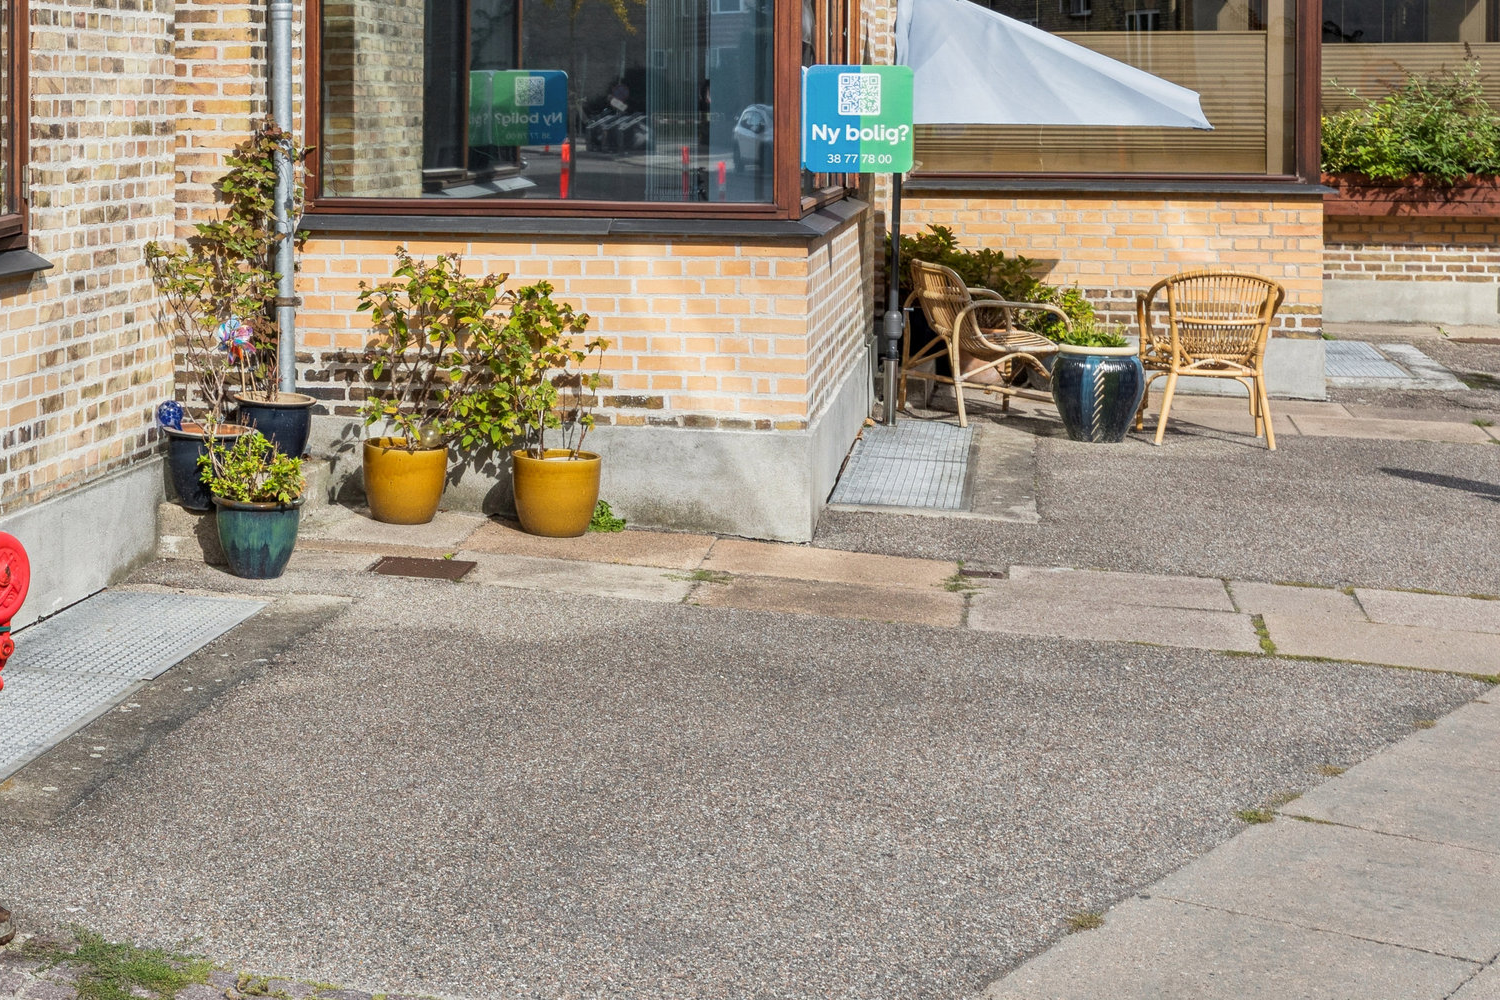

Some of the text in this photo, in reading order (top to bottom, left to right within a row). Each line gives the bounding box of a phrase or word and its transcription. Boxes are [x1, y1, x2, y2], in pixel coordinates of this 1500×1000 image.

[811, 124, 910, 145] Ny bolig?
[827, 154, 892, 164] 38 77 78 00
